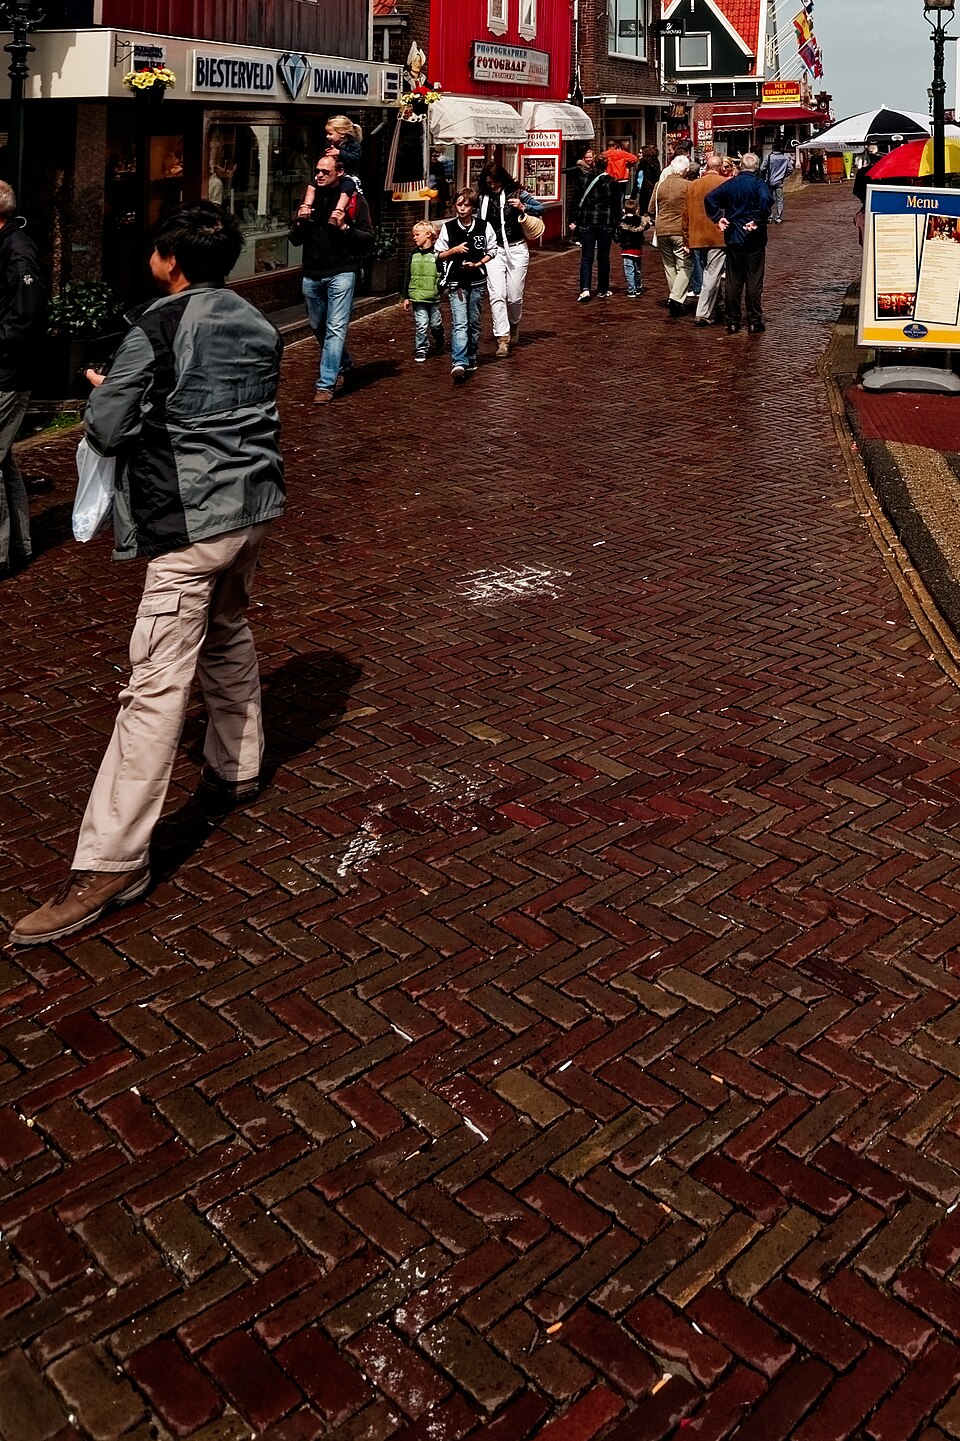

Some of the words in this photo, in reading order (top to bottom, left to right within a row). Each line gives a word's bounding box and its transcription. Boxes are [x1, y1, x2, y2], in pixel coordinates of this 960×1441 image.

[476, 44, 528, 59] PHOTOGRAPHER
[196, 57, 274, 91] BIESTERVELD
[314, 68, 369, 96] DIAMANTAIRS
[905, 195, 939, 209] Menu
